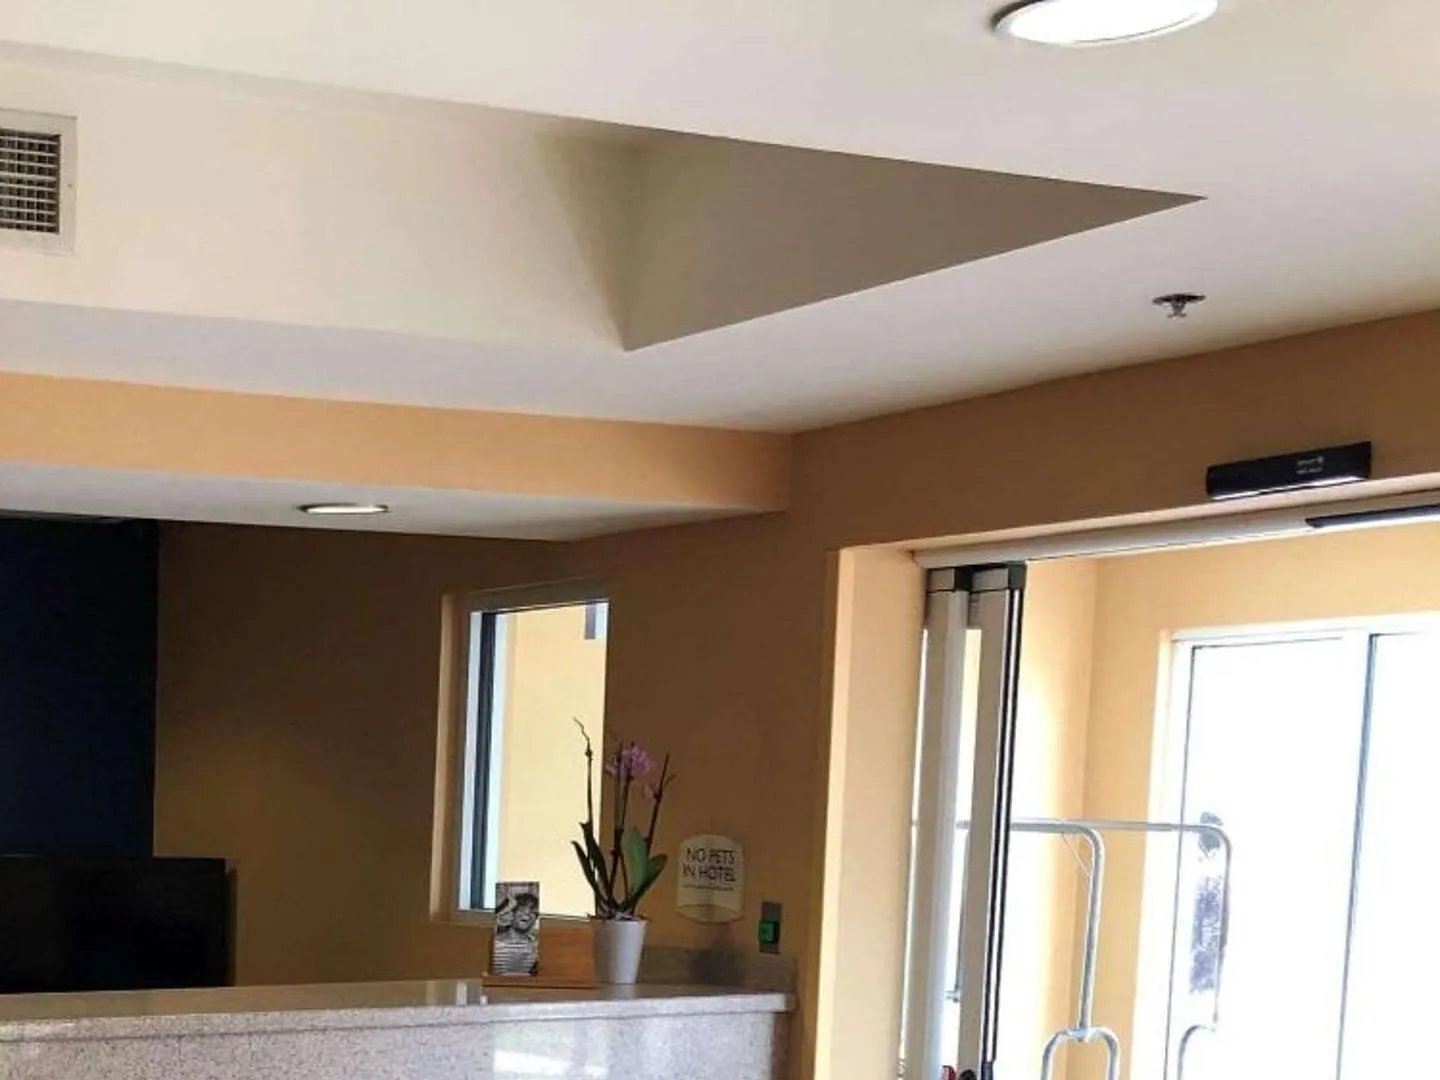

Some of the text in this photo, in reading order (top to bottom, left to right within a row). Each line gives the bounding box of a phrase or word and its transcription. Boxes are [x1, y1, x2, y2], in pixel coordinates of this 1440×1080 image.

[686, 847, 735, 864] NO PETS
[682, 862, 737, 882] IN HOTEL
